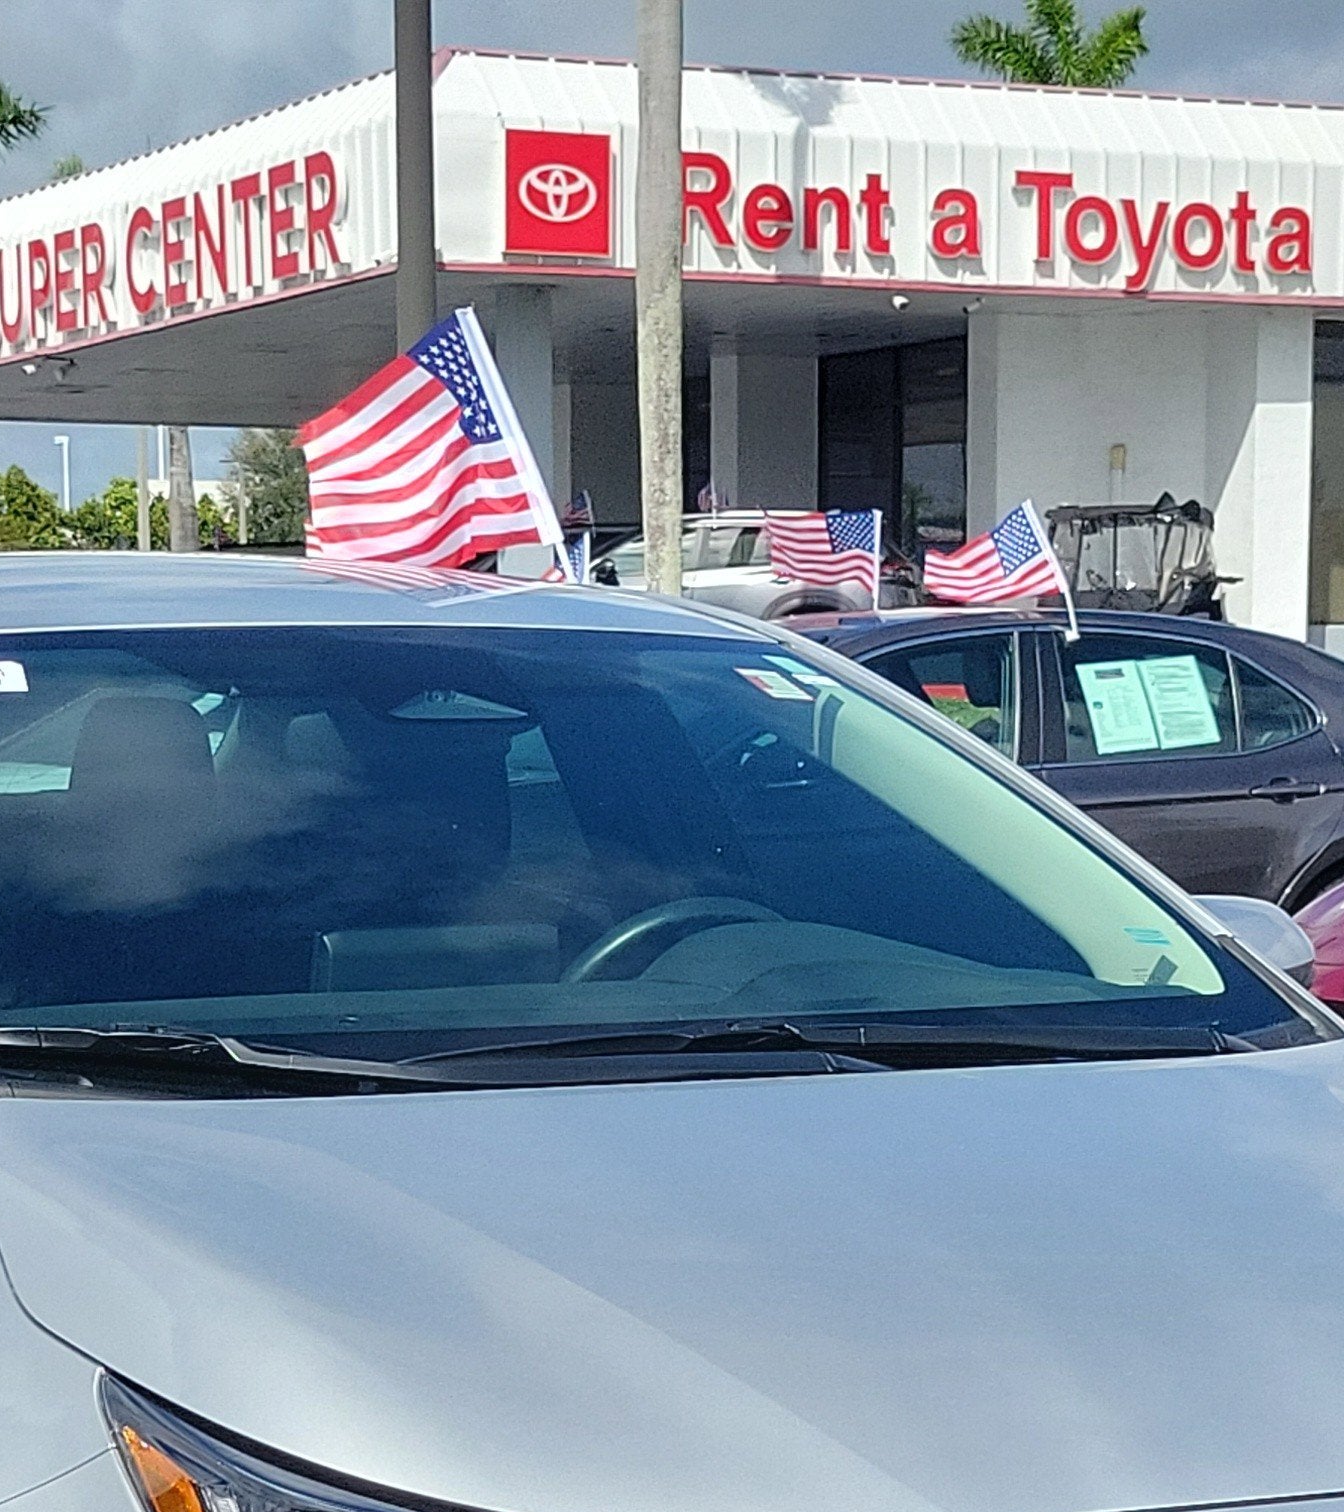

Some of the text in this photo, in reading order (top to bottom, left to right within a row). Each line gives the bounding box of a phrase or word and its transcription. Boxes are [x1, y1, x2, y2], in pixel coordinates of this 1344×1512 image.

[127, 150, 341, 315] CENTER
[681, 151, 1313, 292] Rent a Toyota
